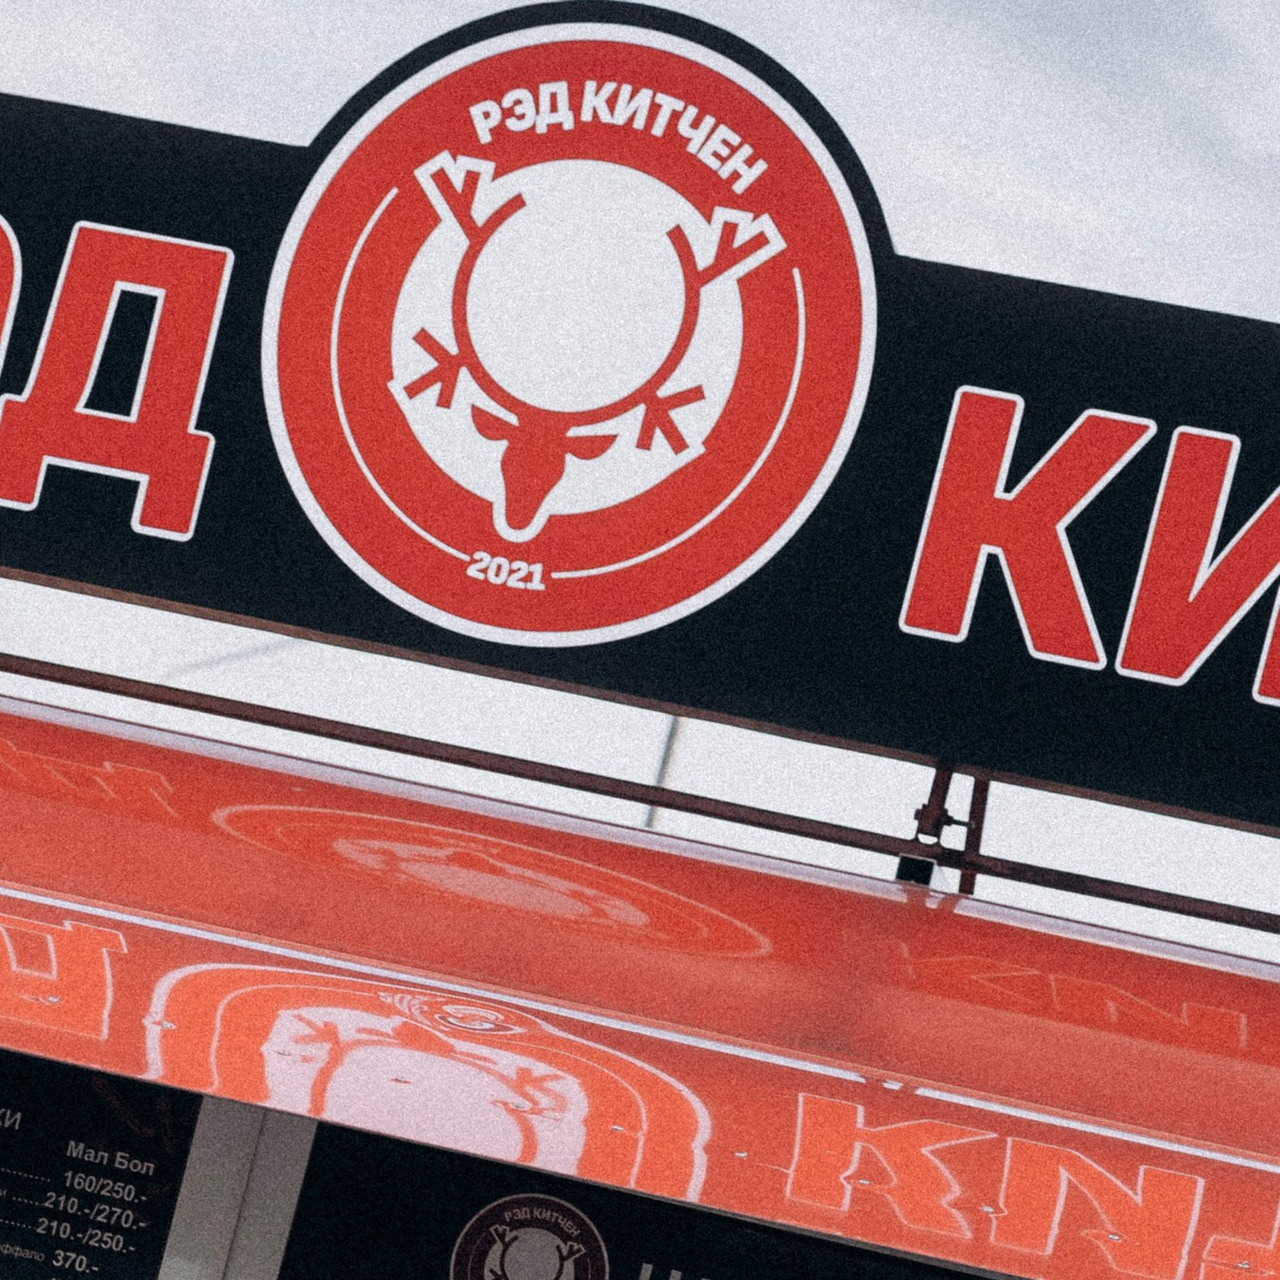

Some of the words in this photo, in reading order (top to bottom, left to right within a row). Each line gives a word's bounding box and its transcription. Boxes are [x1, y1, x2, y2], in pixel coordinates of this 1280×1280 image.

[468, 81, 573, 146] РЭД
[579, 80, 769, 196] КИТЧЕН
[467, 550, 547, 594] 2021
[66, 1140, 109, 1165] Мал
[113, 1151, 155, 1175] Бол
[64, 1170, 147, 1203] 160/250.-
[43, 1191, 146, 1230] 210.-/270.-
[503, 1208, 531, 1223] РЭД
[532, 1207, 582, 1238] КИТЧЕН
[35, 1217, 135, 1253] 210.-/250.-
[52, 1249, 99, 1273] 370.-
